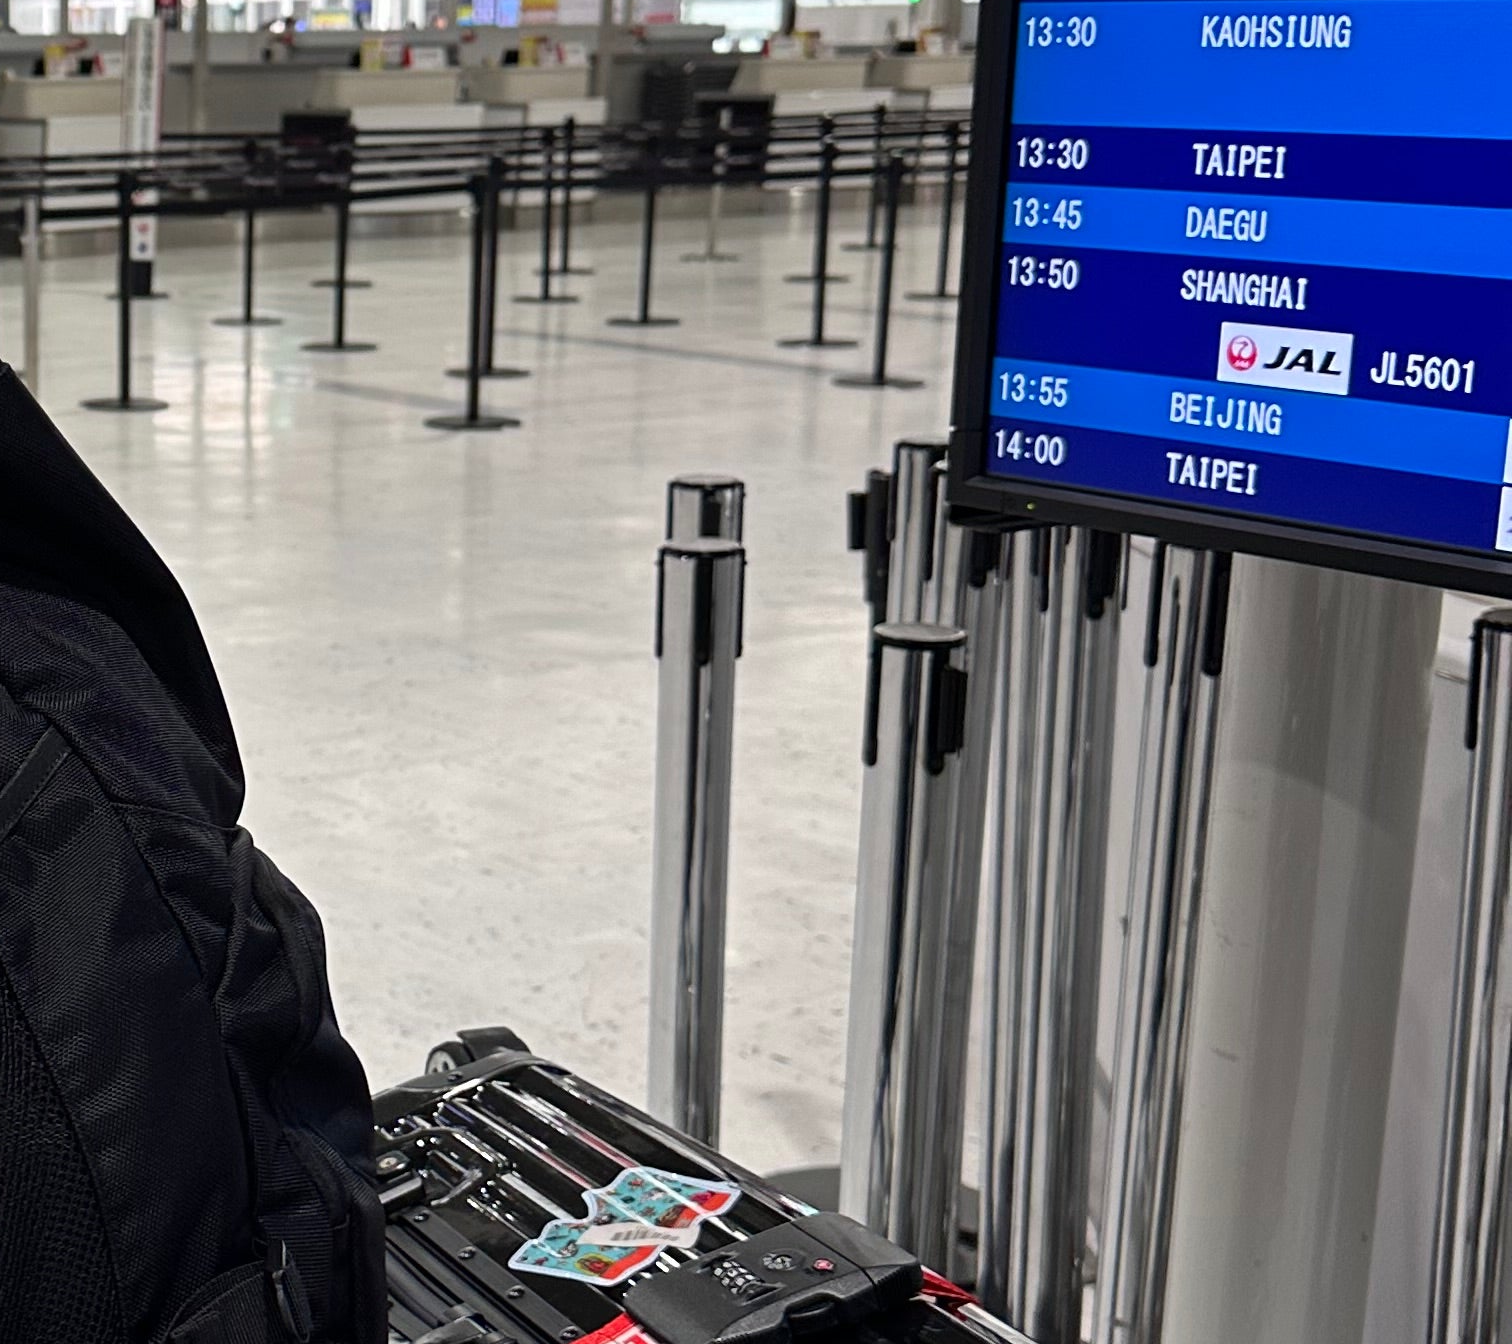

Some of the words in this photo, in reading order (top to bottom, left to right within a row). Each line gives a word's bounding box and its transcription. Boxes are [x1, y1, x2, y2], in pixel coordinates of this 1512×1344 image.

[1027, 16, 1096, 47] 13:30
[1201, 15, 1351, 48] KAOHSIUNG
[1017, 137, 1087, 170] 13:30
[1192, 143, 1286, 179] TAIPEI
[1014, 198, 1082, 230] 13:45
[1186, 206, 1267, 242] DAEGU
[1008, 256, 1078, 290] 13:50
[1180, 269, 1307, 311] SHANGHAI
[1263, 346, 1342, 375] JAL
[1370, 350, 1475, 394] JL5601
[1000, 372, 1068, 407] 13:55
[1170, 392, 1282, 435] BEIJING
[995, 429, 1064, 466] 14:00
[1166, 452, 1257, 495] TAIPEI
